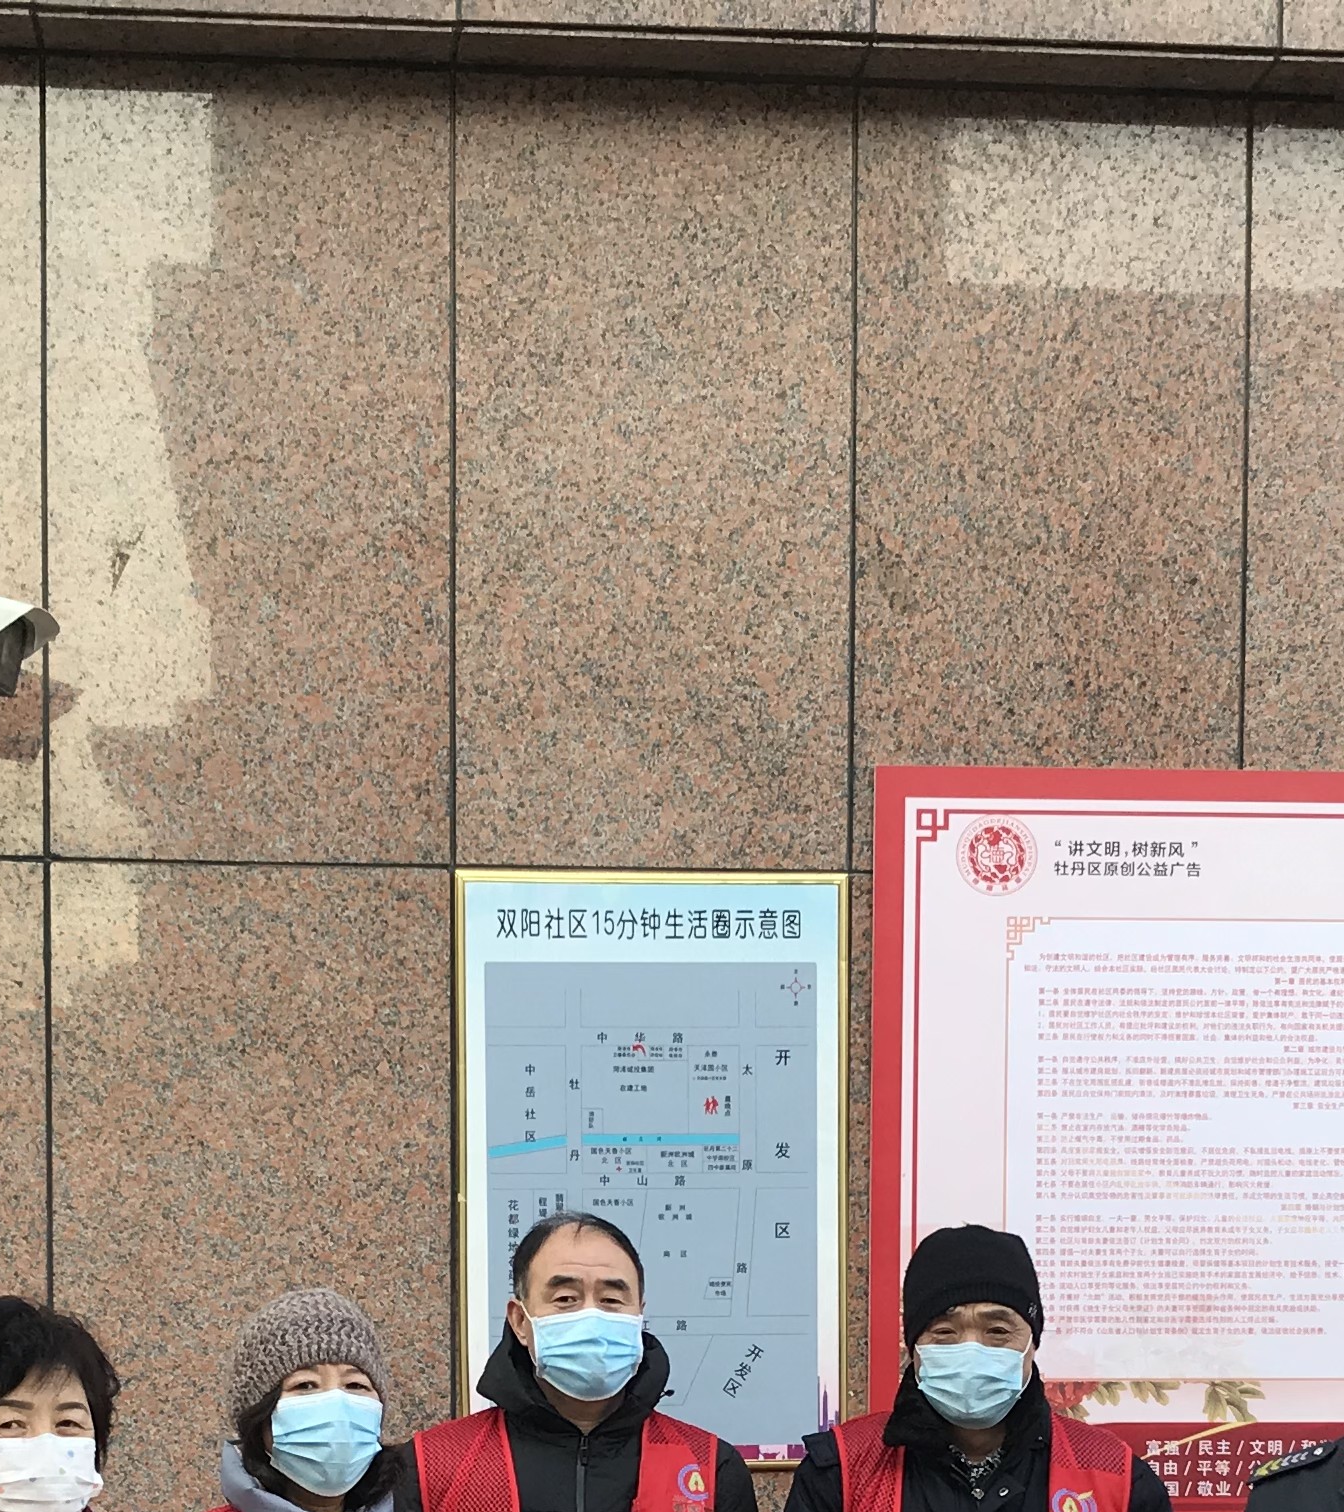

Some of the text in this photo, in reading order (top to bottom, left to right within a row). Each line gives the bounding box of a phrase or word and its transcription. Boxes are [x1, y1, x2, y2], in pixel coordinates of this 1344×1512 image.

[1053, 861, 1202, 878] 牡丹区原创公益广告
[496, 908, 802, 941] 双阳社区15分钟生活圈示意图
[1145, 1439, 1180, 1457] 富强
[1198, 1440, 1232, 1457] 民主
[1249, 1440, 1284, 1457] 文明
[1197, 1460, 1231, 1477] 平等
[1197, 1481, 1232, 1497] 敬业
